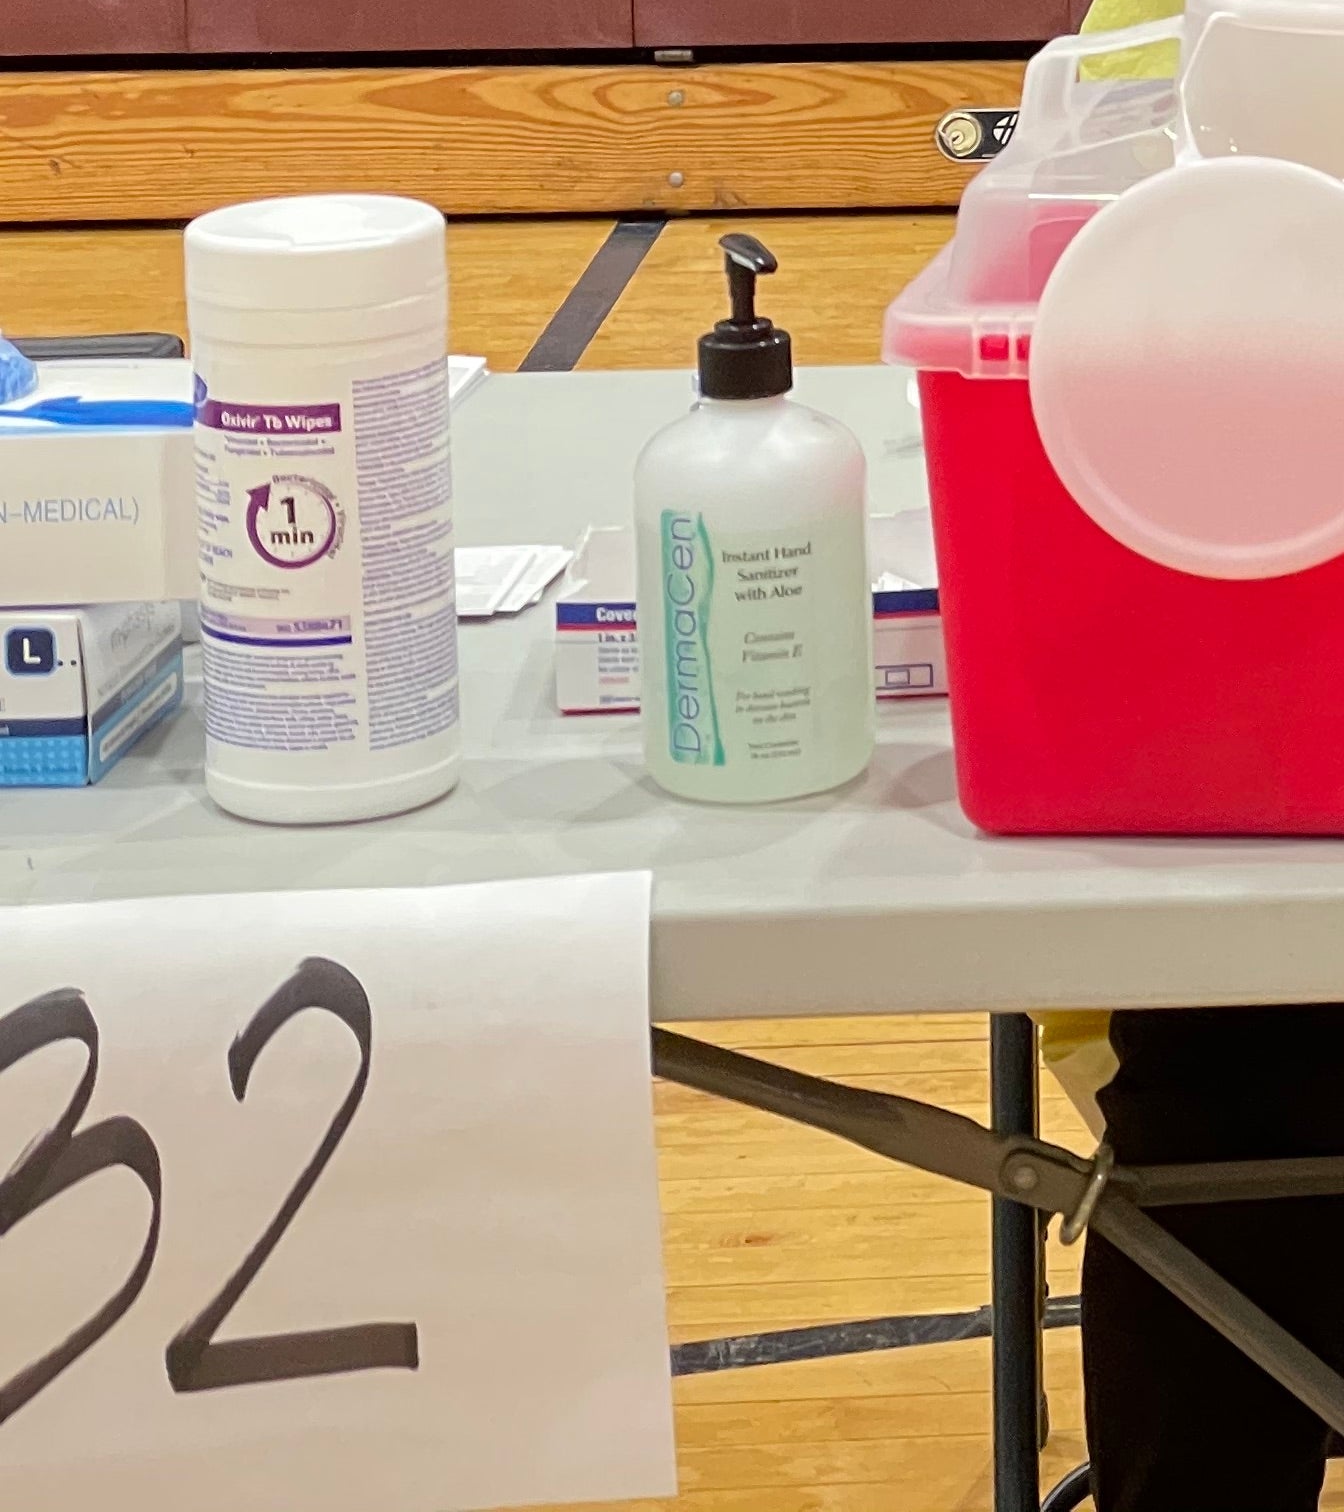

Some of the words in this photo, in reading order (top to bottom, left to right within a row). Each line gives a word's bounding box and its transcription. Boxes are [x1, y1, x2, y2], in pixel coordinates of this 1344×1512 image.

[285, 414, 333, 432] Wipes
[280, 496, 296, 524] 1
[271, 526, 314, 545] min
[721, 549, 770, 563] Instant
[775, 541, 811, 559] Hand
[737, 567, 799, 582] Sanitizer
[735, 587, 767, 602] with
[770, 584, 802, 599] Aloe
[667, 517, 701, 753] DermaCen
[22, 638, 41, 665] L
